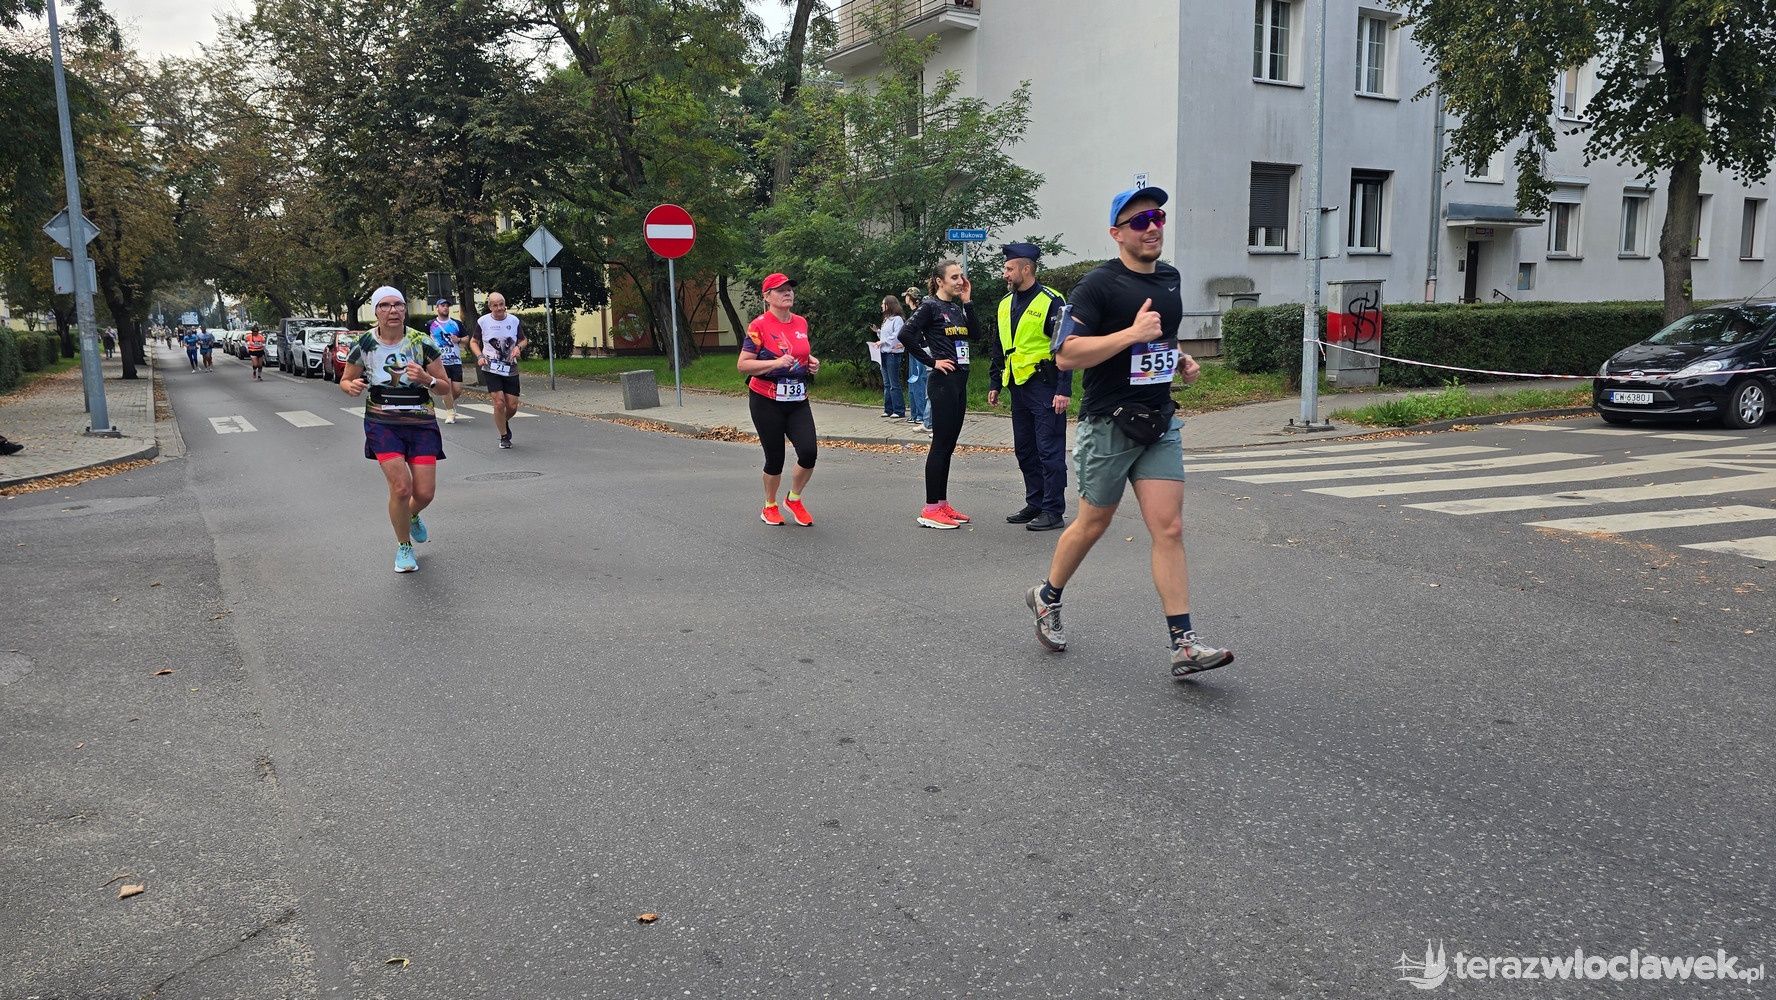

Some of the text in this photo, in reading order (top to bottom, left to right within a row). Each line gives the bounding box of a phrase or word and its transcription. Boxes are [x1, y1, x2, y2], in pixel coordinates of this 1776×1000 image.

[960, 231, 984, 239] Bukowa
[1140, 351, 1174, 372] 555
[783, 384, 802, 395] 138
[1614, 393, 1625, 401] CW
